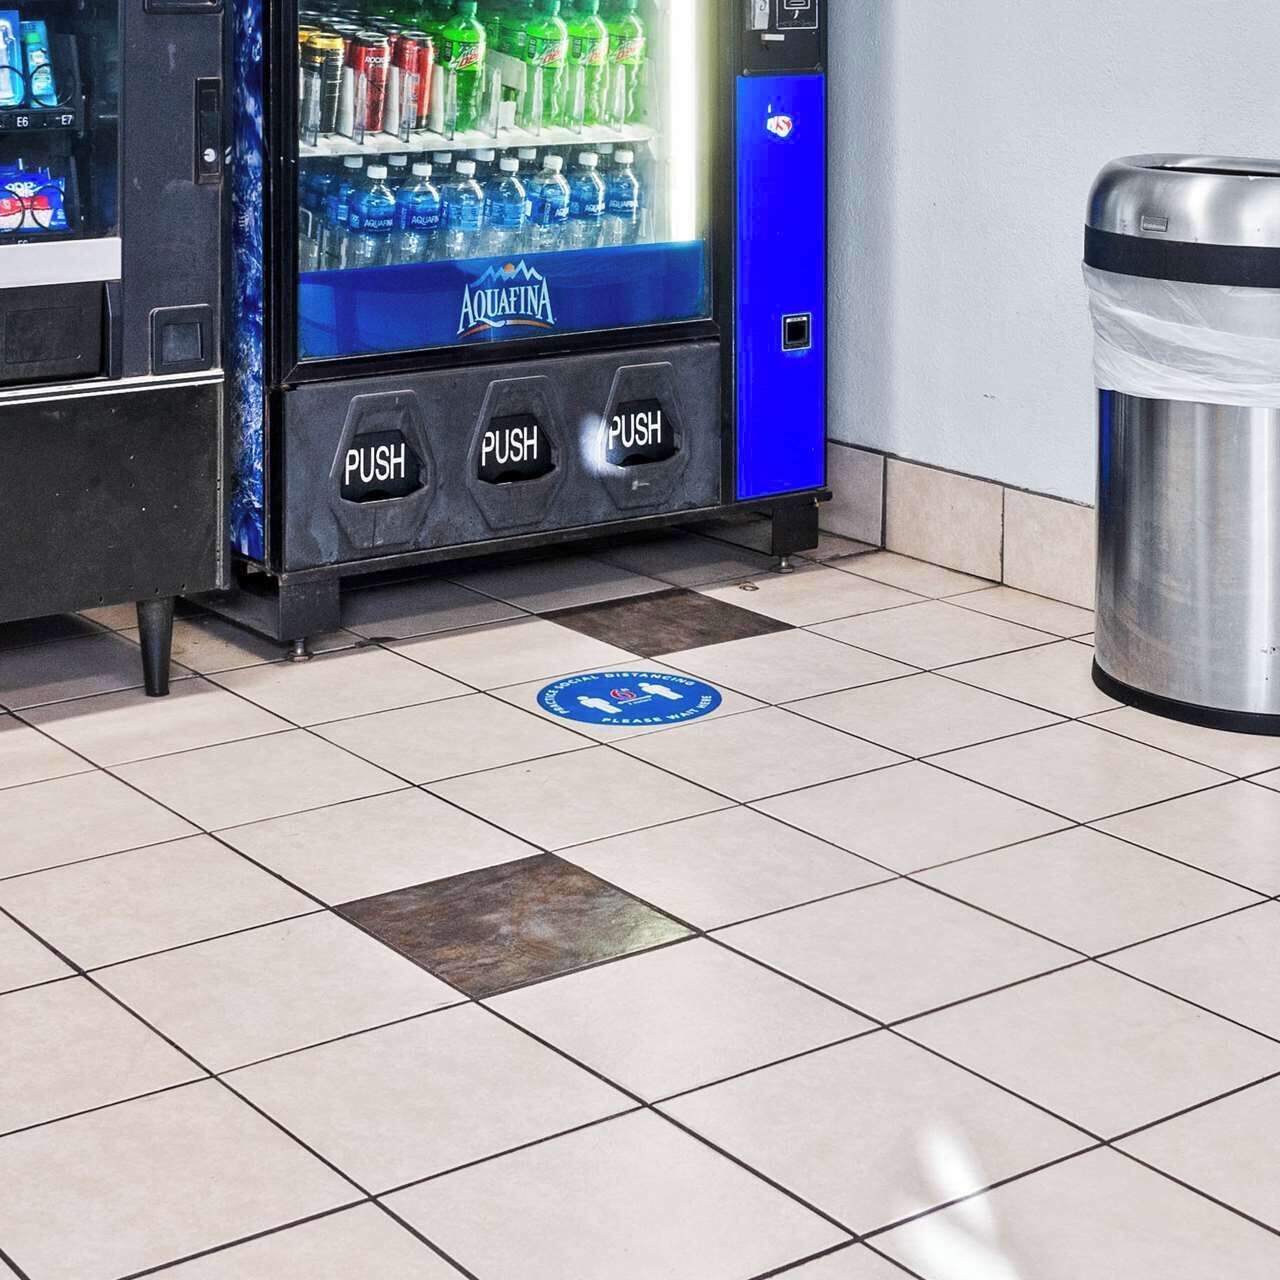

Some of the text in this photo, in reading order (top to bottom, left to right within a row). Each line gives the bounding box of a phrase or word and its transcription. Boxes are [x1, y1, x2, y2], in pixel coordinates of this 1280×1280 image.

[16, 117, 28, 127] E6
[61, 115, 73, 125] E7
[456, 277, 556, 336] AQUAFINA
[481, 425, 538, 466] PUSH
[609, 411, 662, 450] PUSH
[345, 442, 406, 485] PUSH
[544, 671, 696, 714] PRACTICE SOCIAL DISTANCING
[601, 695, 712, 724] PLEASE WAIT HERE
